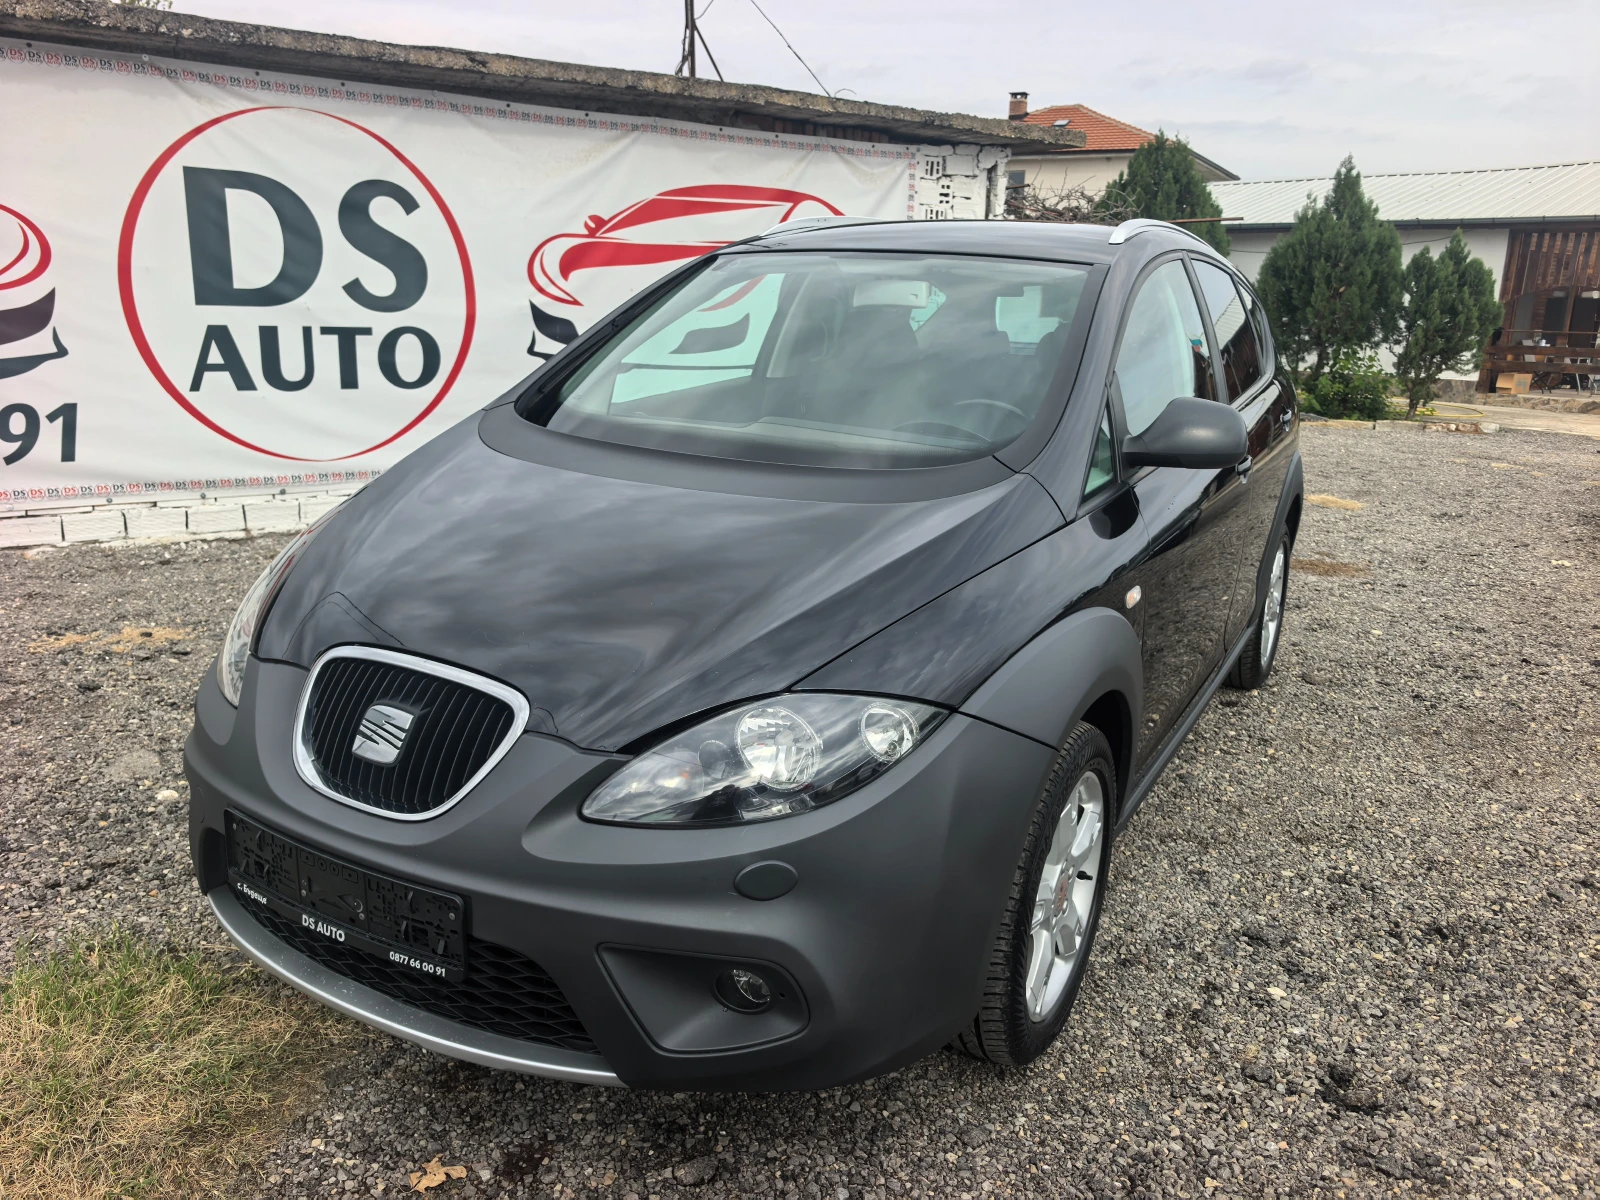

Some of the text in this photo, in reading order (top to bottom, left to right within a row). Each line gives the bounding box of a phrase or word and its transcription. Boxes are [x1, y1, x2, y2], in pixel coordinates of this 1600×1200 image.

[10, 48, 23, 56] DS
[28, 51, 41, 59] DS
[46, 53, 60, 61] DS
[64, 55, 77, 63] DS
[82, 57, 94, 65] DS
[134, 63, 146, 71] DS
[182, 166, 428, 313] DS
[189, 324, 442, 392] AUTO
[0, 403, 78, 466] 91
[302, 914, 345, 942] DS AUTO
[390, 951, 446, 977] 0877 66 00 91
